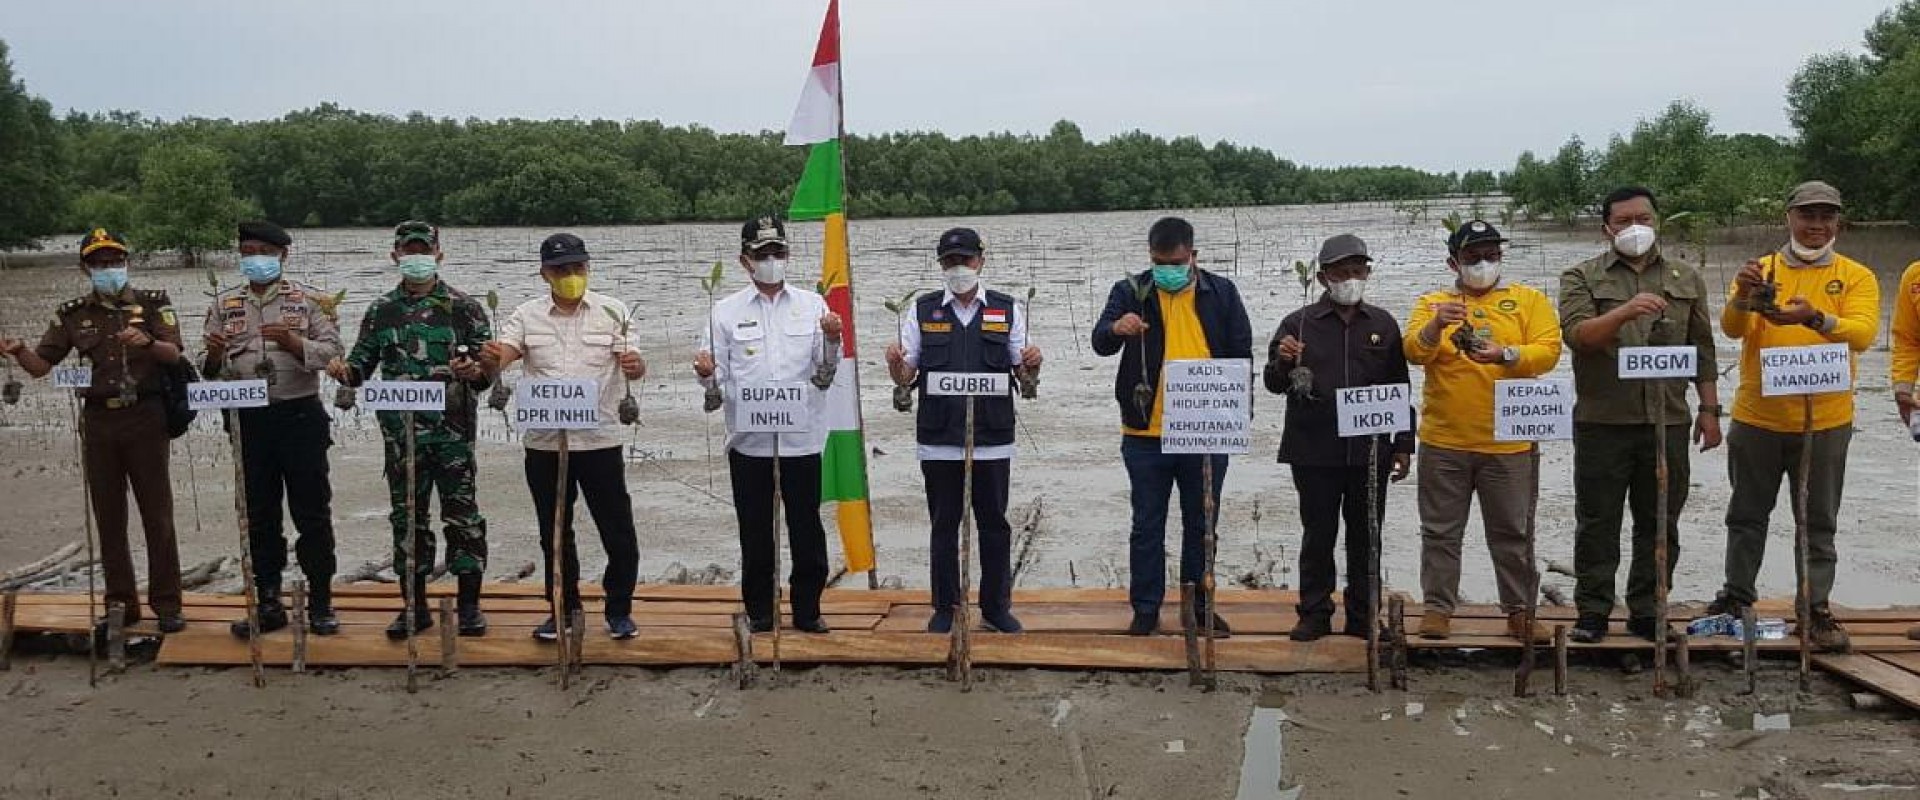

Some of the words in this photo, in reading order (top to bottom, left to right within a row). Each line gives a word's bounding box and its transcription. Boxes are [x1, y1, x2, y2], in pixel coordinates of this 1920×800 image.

[1626, 354, 1689, 370] BRGM
[1762, 353, 1816, 367] KEPALA
[1820, 351, 1848, 364] KPH
[1188, 366, 1222, 376] KADIS
[940, 377, 995, 392] GUBRI
[1773, 373, 1840, 387] MANDAH
[189, 385, 266, 402] KAPOLRES
[531, 385, 585, 399] KETUA
[1166, 382, 1245, 393] LINGKUNGAN
[1508, 385, 1560, 397] KEPALA
[365, 387, 442, 403] DANDIM
[742, 388, 800, 402] BUPATI
[1344, 387, 1400, 404] KETUA
[1173, 398, 1209, 409] HIDUP
[1213, 398, 1239, 408] DAN
[517, 409, 550, 422] DPR
[554, 409, 599, 422] INHIL
[751, 411, 794, 425] INHIL
[1502, 405, 1565, 417] BPDASHL
[1170, 420, 1243, 431] KEHUTANAN
[1354, 411, 1394, 427] IKDR
[1511, 424, 1555, 435] INROK
[1162, 437, 1219, 448] PROVINSI
[1222, 437, 1249, 447] RIAU
